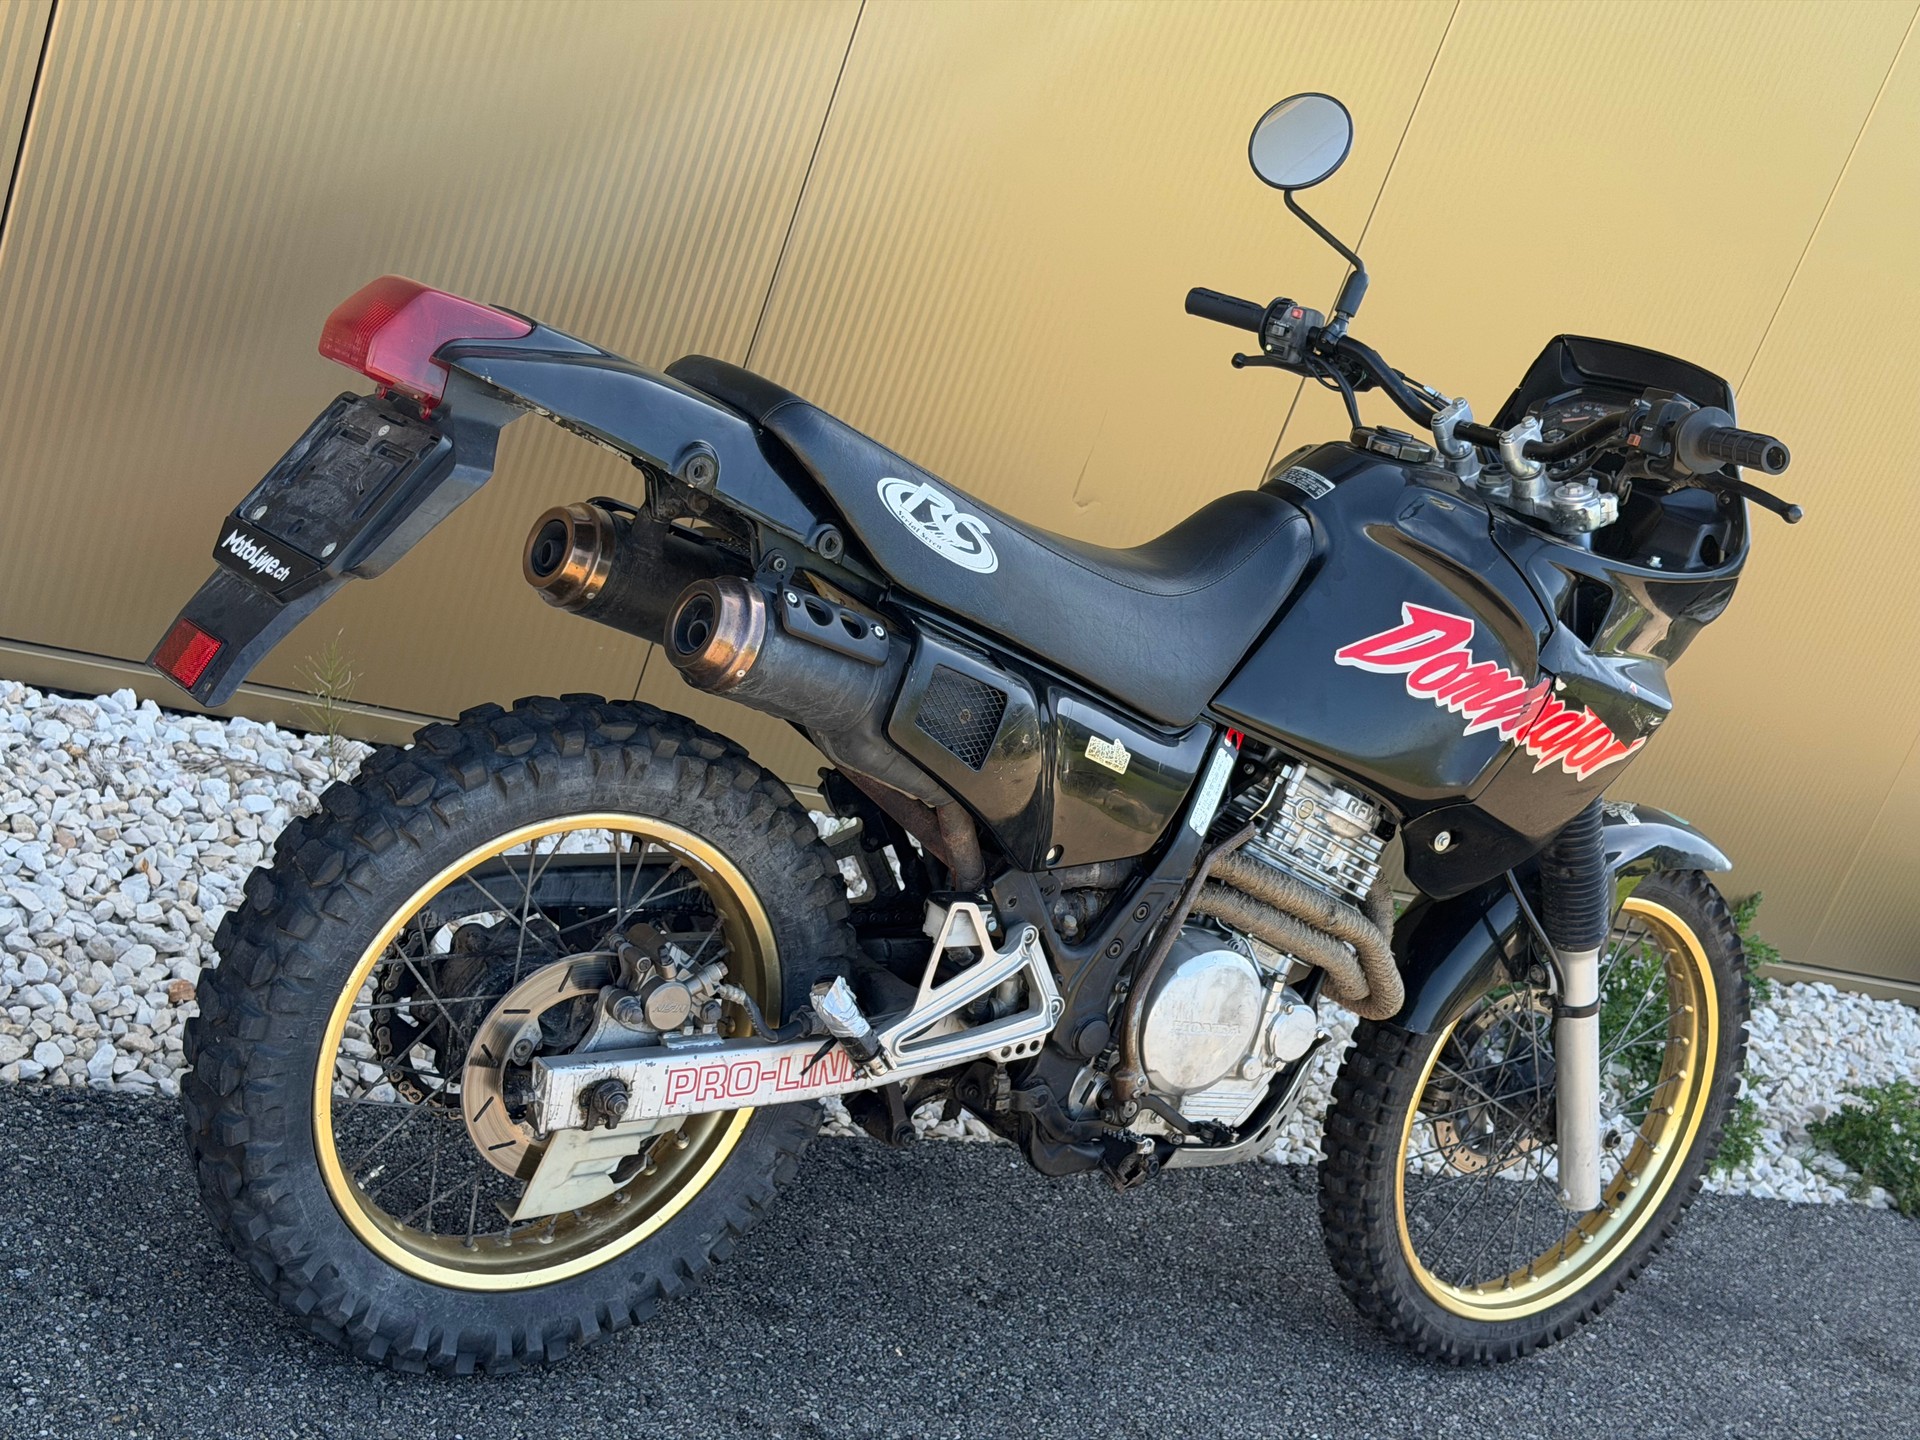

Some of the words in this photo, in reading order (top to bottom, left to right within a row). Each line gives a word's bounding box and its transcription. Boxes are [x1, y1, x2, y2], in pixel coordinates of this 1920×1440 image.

[897, 509, 920, 533] Serial
[921, 531, 942, 550] Seven
[221, 528, 291, 582] MotoLine.ch
